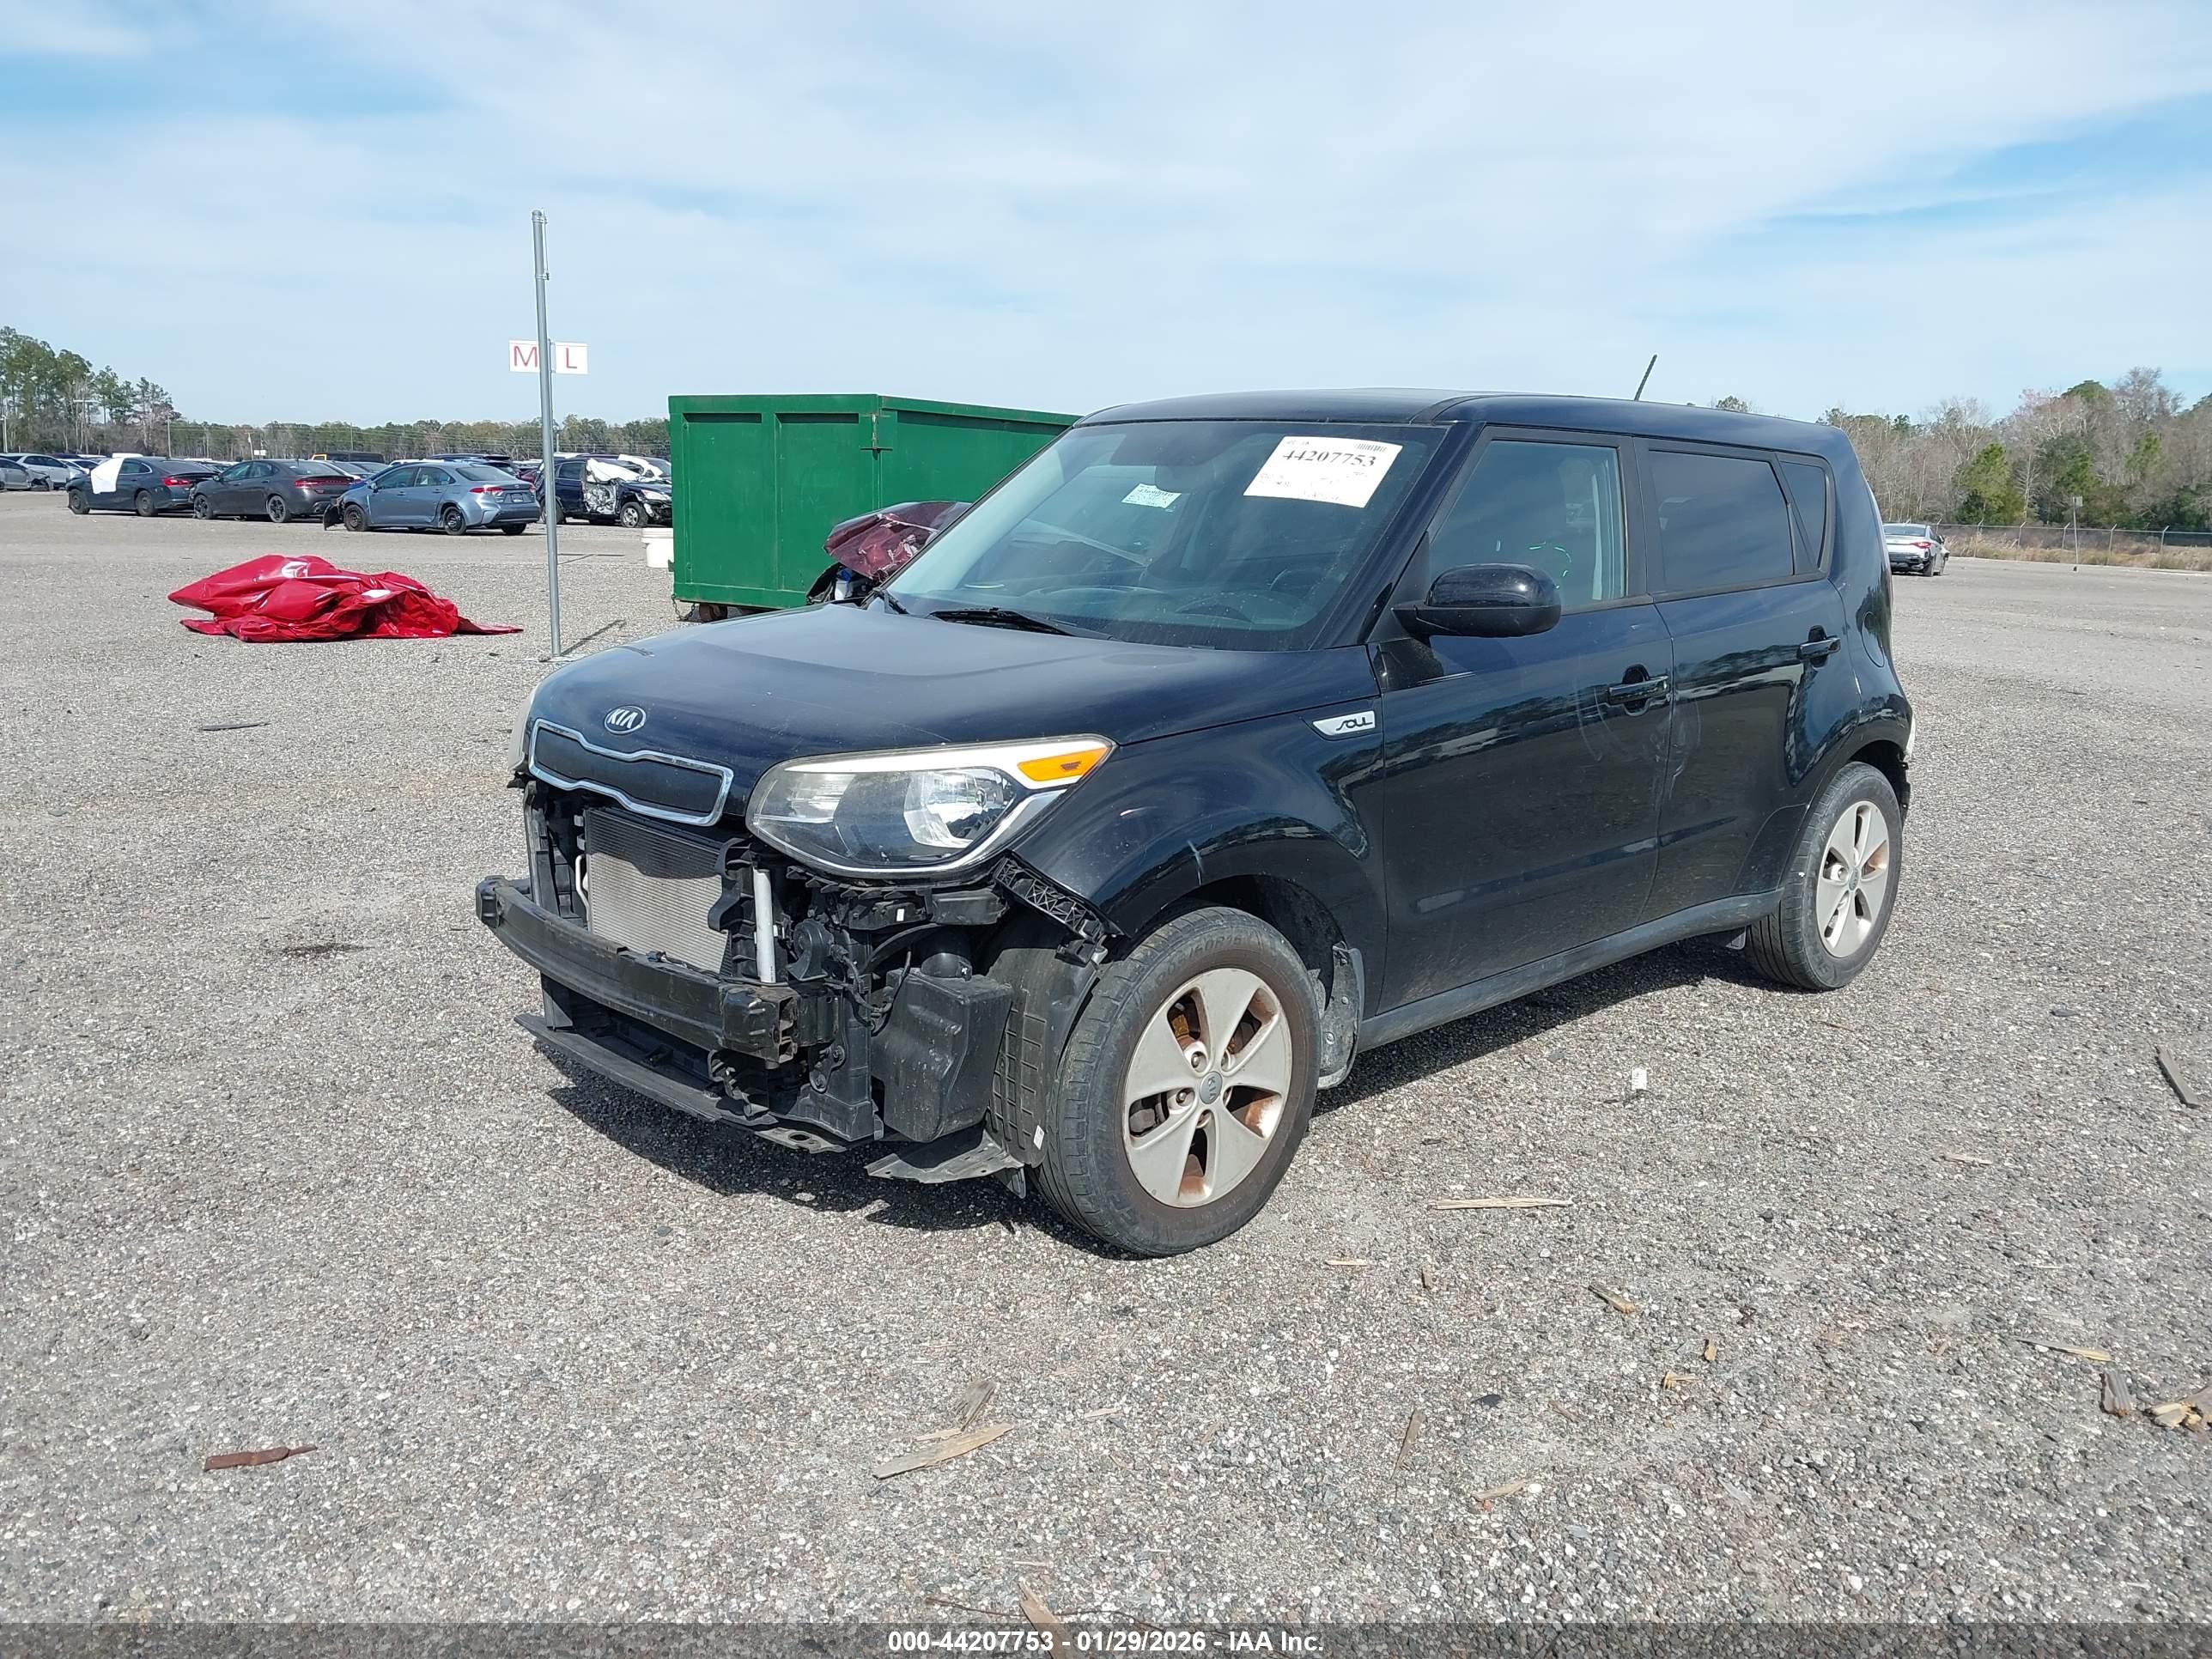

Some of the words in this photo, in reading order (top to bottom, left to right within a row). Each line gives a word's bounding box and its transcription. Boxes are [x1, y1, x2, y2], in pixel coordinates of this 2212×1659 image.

[514, 345, 538, 367] M
[565, 347, 577, 368] L
[1283, 450, 1376, 466] 44207753
[606, 708, 638, 729] KIA
